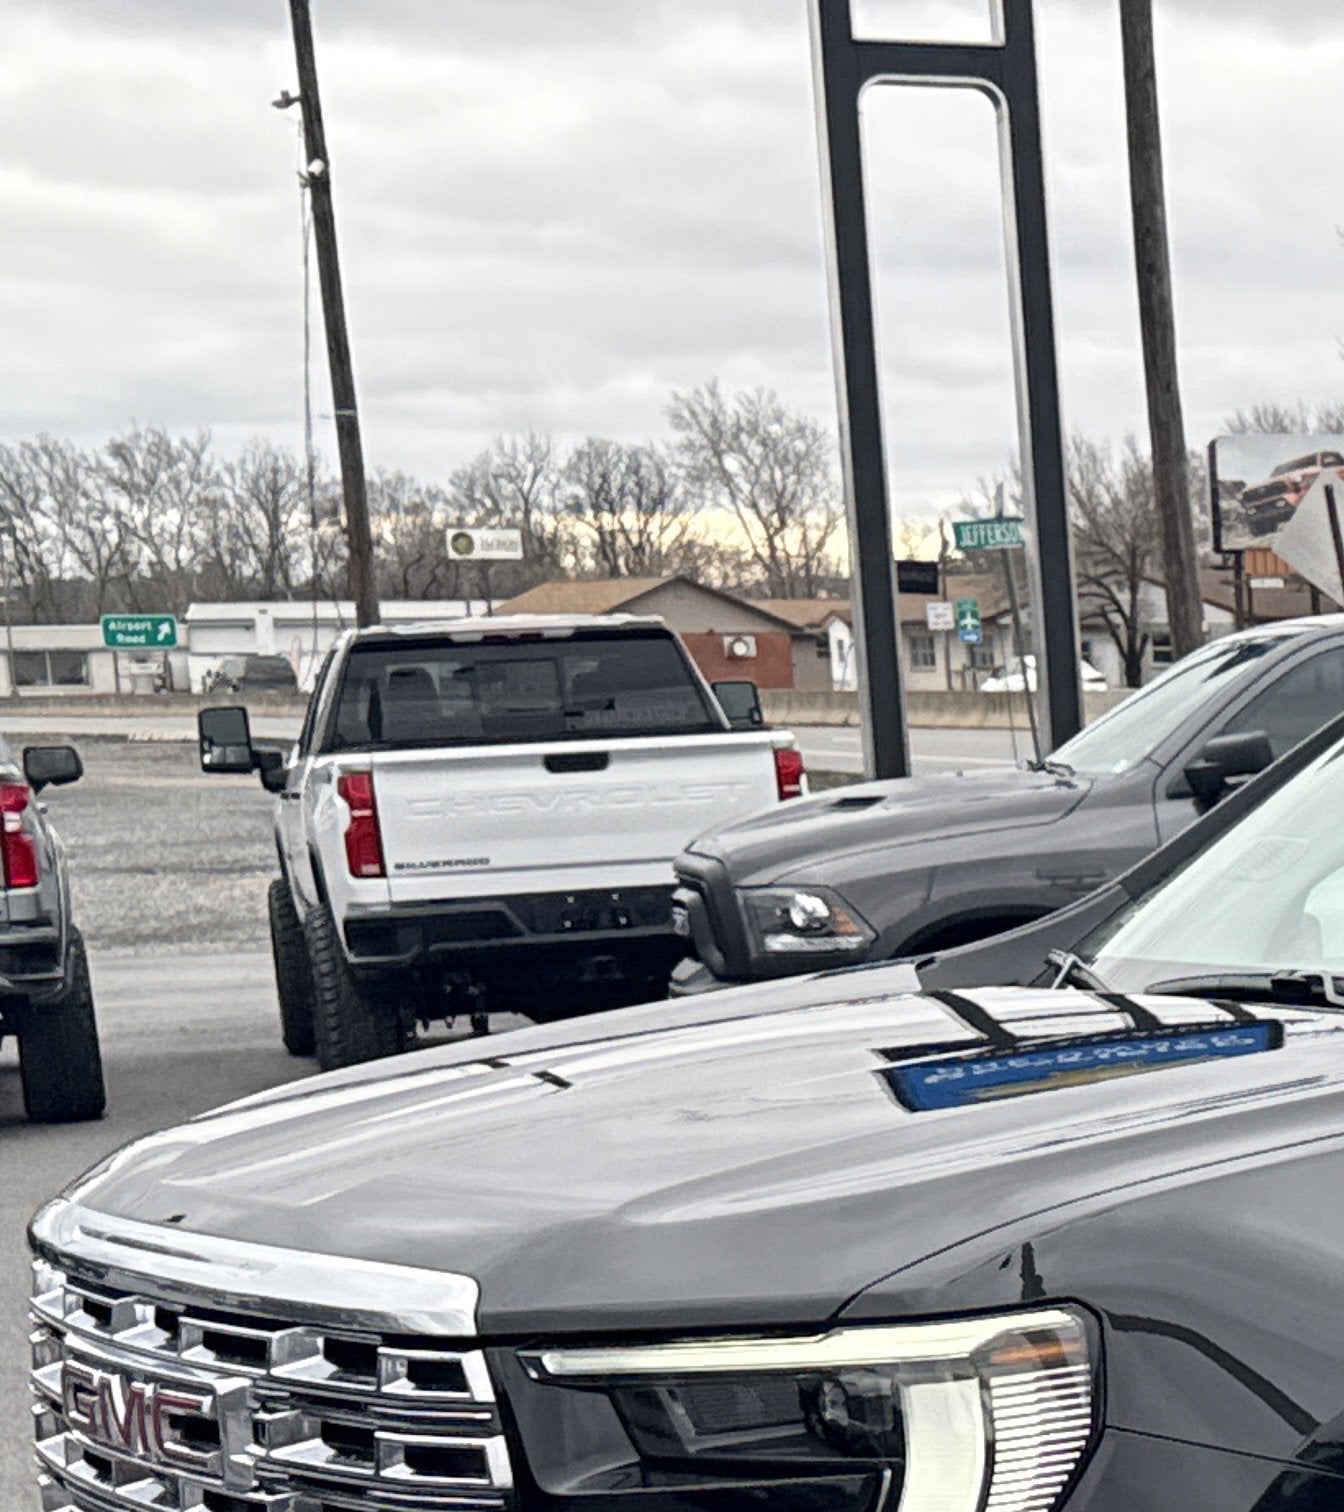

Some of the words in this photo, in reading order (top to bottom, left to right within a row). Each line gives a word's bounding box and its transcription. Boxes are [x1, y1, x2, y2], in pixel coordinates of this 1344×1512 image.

[108, 620, 152, 632] Airport
[404, 781, 750, 819] CHEVROLET
[61, 1359, 217, 1470] GMC
